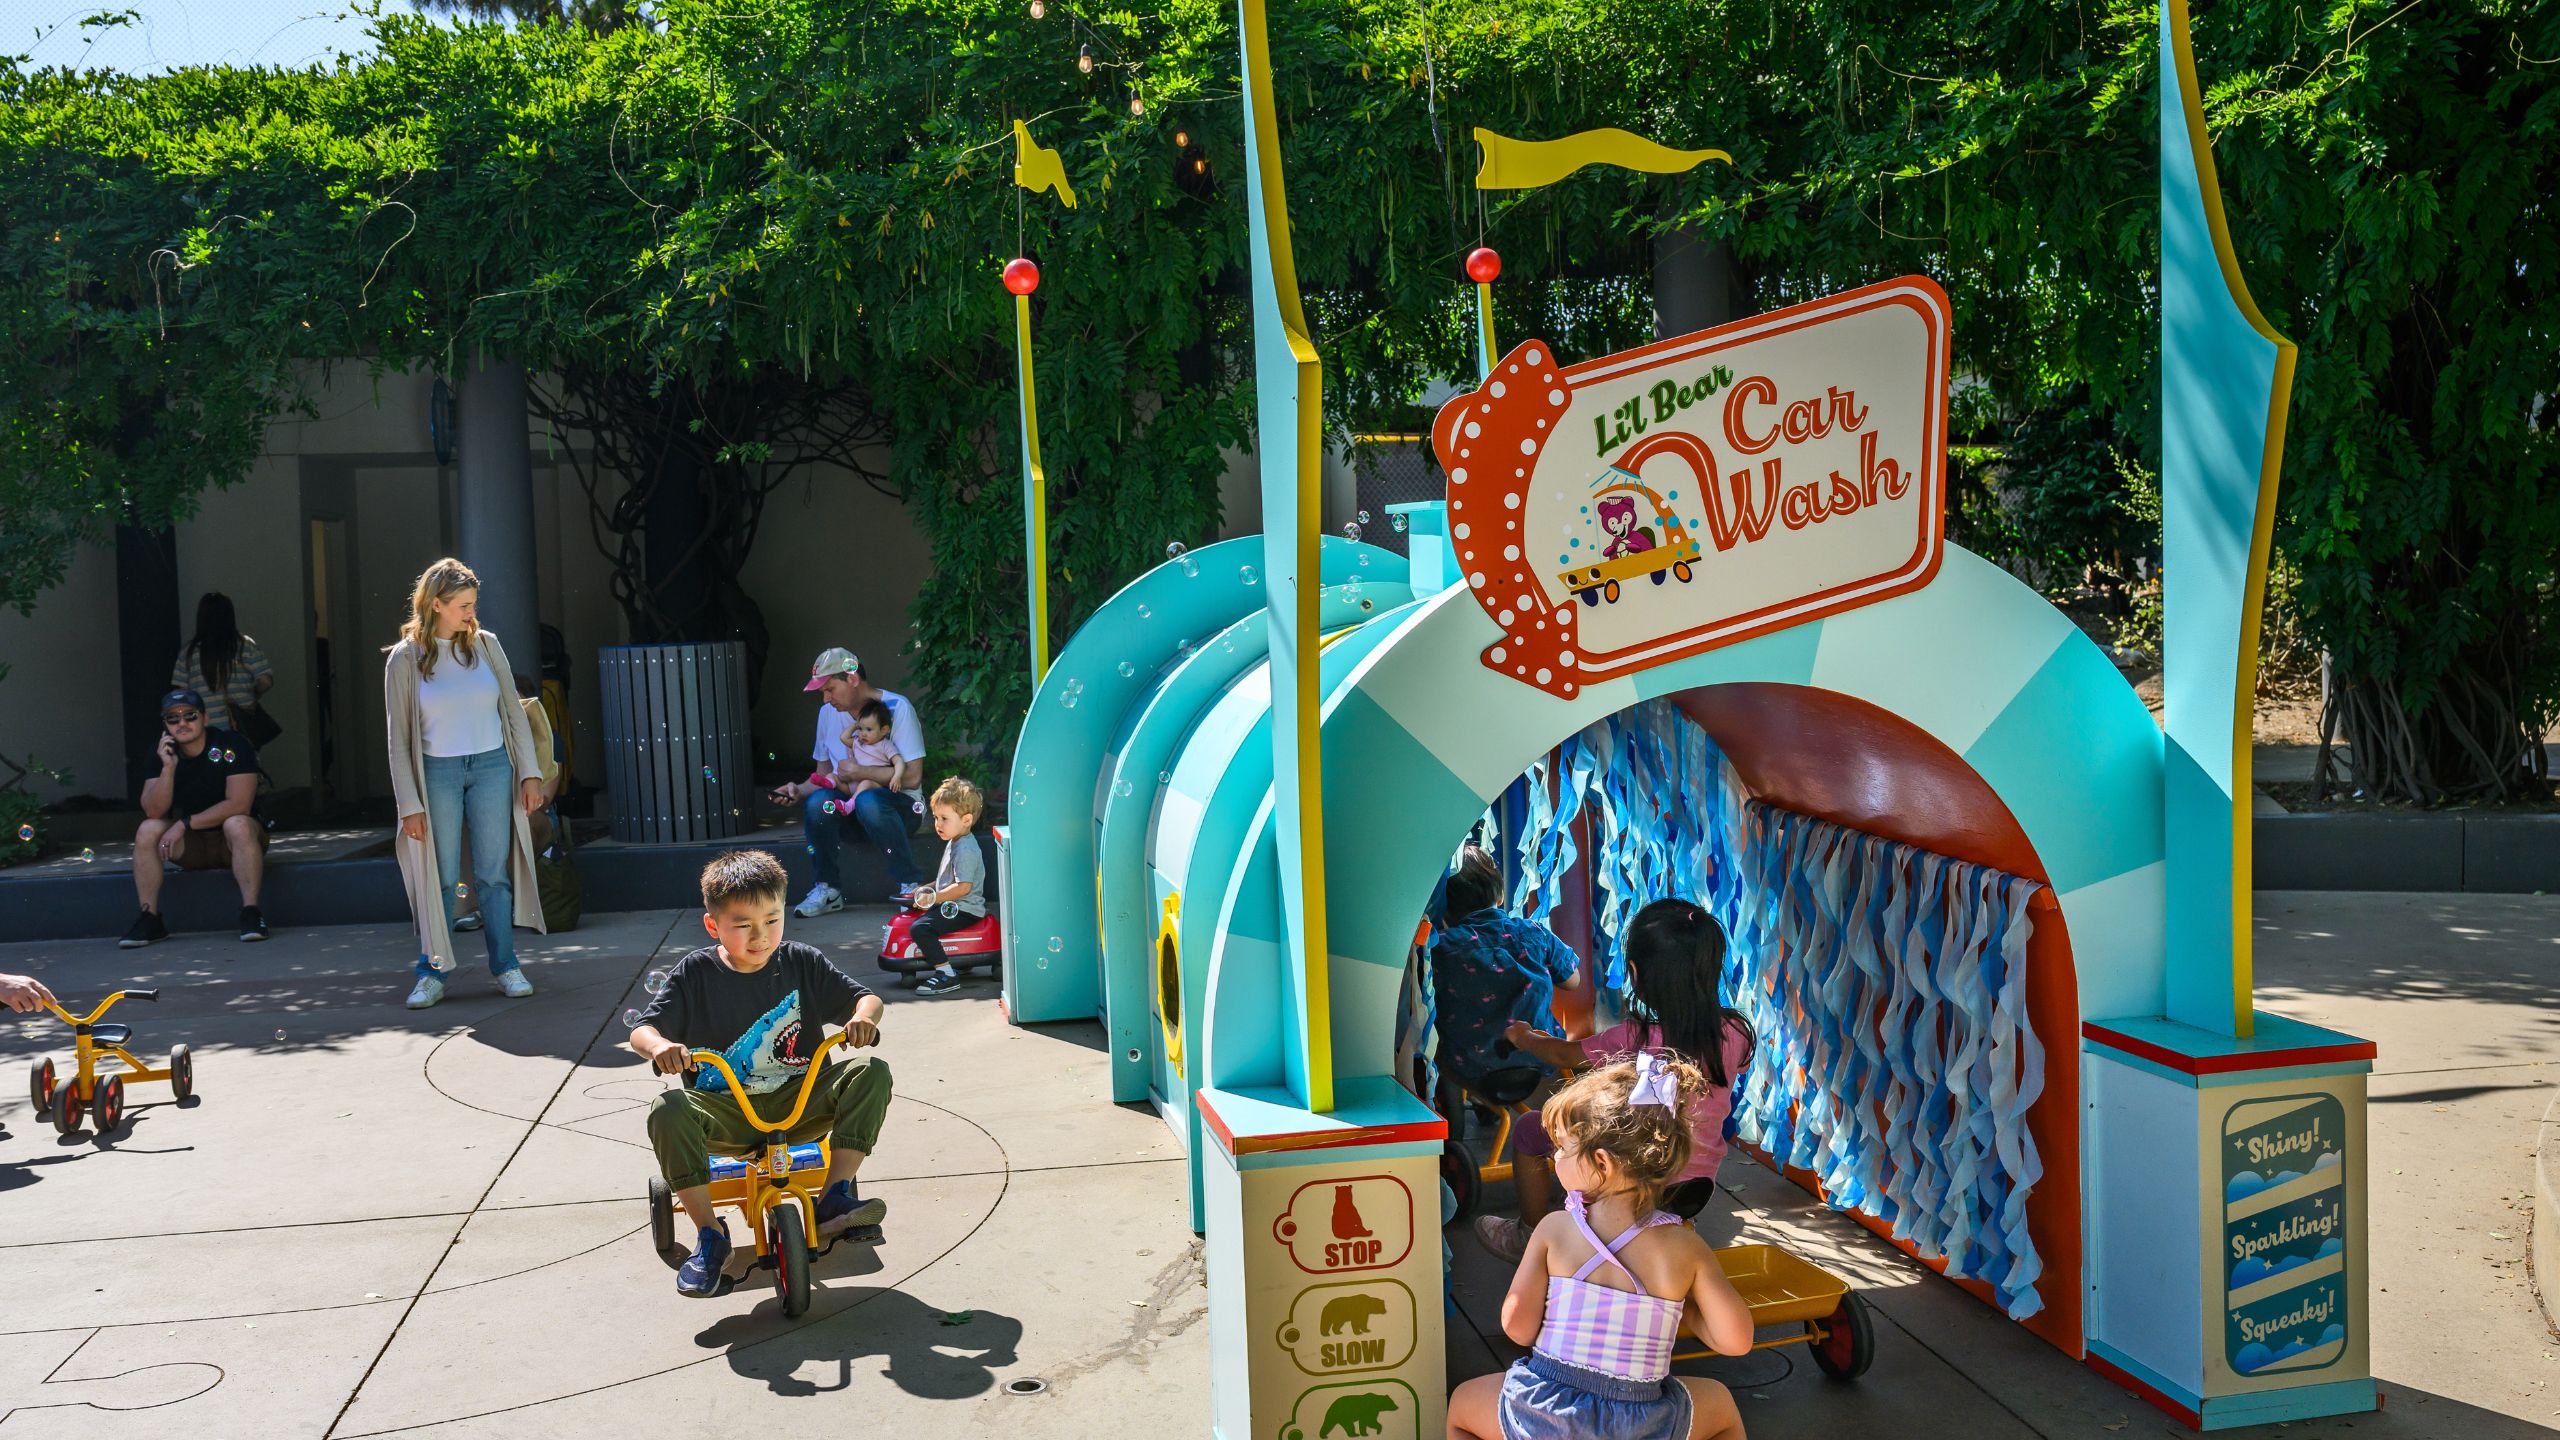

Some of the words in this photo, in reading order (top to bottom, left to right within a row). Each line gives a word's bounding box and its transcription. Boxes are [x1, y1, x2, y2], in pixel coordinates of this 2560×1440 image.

[1647, 363, 1735, 424] Bear
[1722, 375, 1870, 455] Car
[1698, 430, 1912, 553] Wash
[2247, 1116, 2321, 1165] Shiny!
[1324, 1238, 1382, 1267] STOP
[2231, 1202, 2340, 1261] Sparkling!
[2240, 1289, 2335, 1343] Squeaky!
[1320, 1337, 1386, 1368] SLOW
